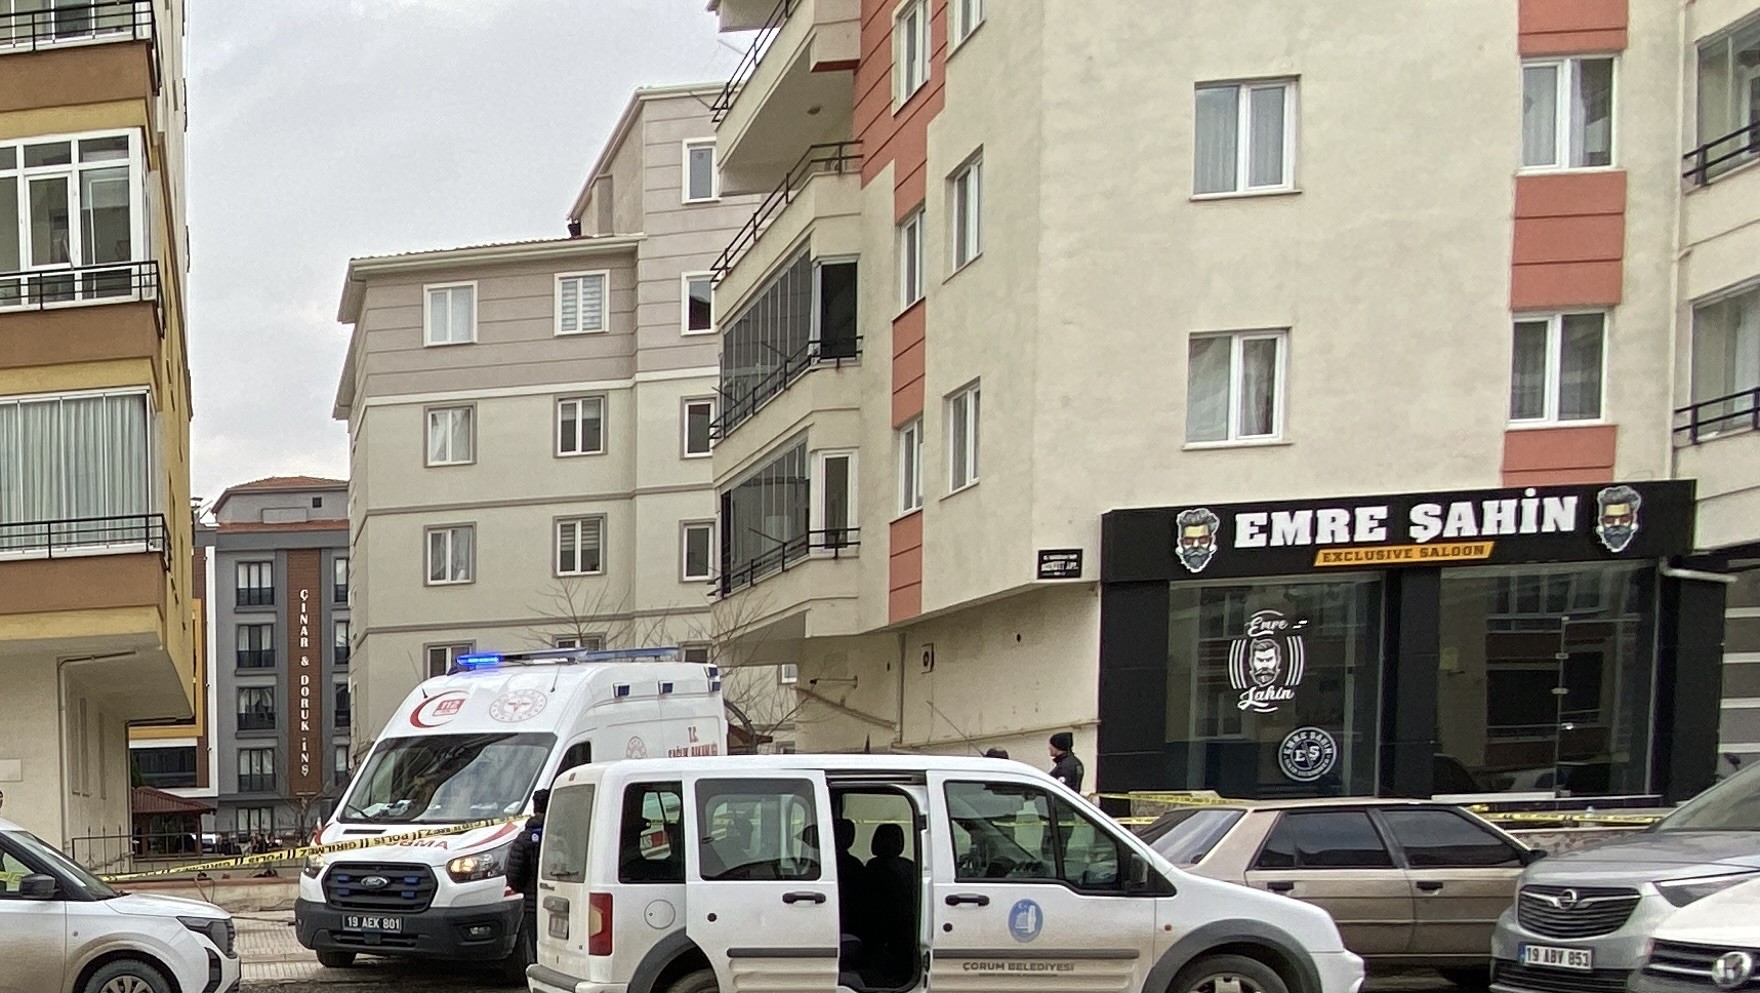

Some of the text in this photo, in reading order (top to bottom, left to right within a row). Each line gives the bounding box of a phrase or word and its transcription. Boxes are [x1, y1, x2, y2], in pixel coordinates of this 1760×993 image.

[1234, 488, 1578, 548] EMRE ŞAHİN
[1322, 544, 1486, 563] EXCLUSIVE SALOON
[299, 589, 309, 648] ÇINAR
[300, 655, 310, 667] &
[300, 674, 310, 731] DORUK
[348, 916, 400, 929] 19 AEK 801
[1526, 947, 1589, 966] 19 ABV 853
